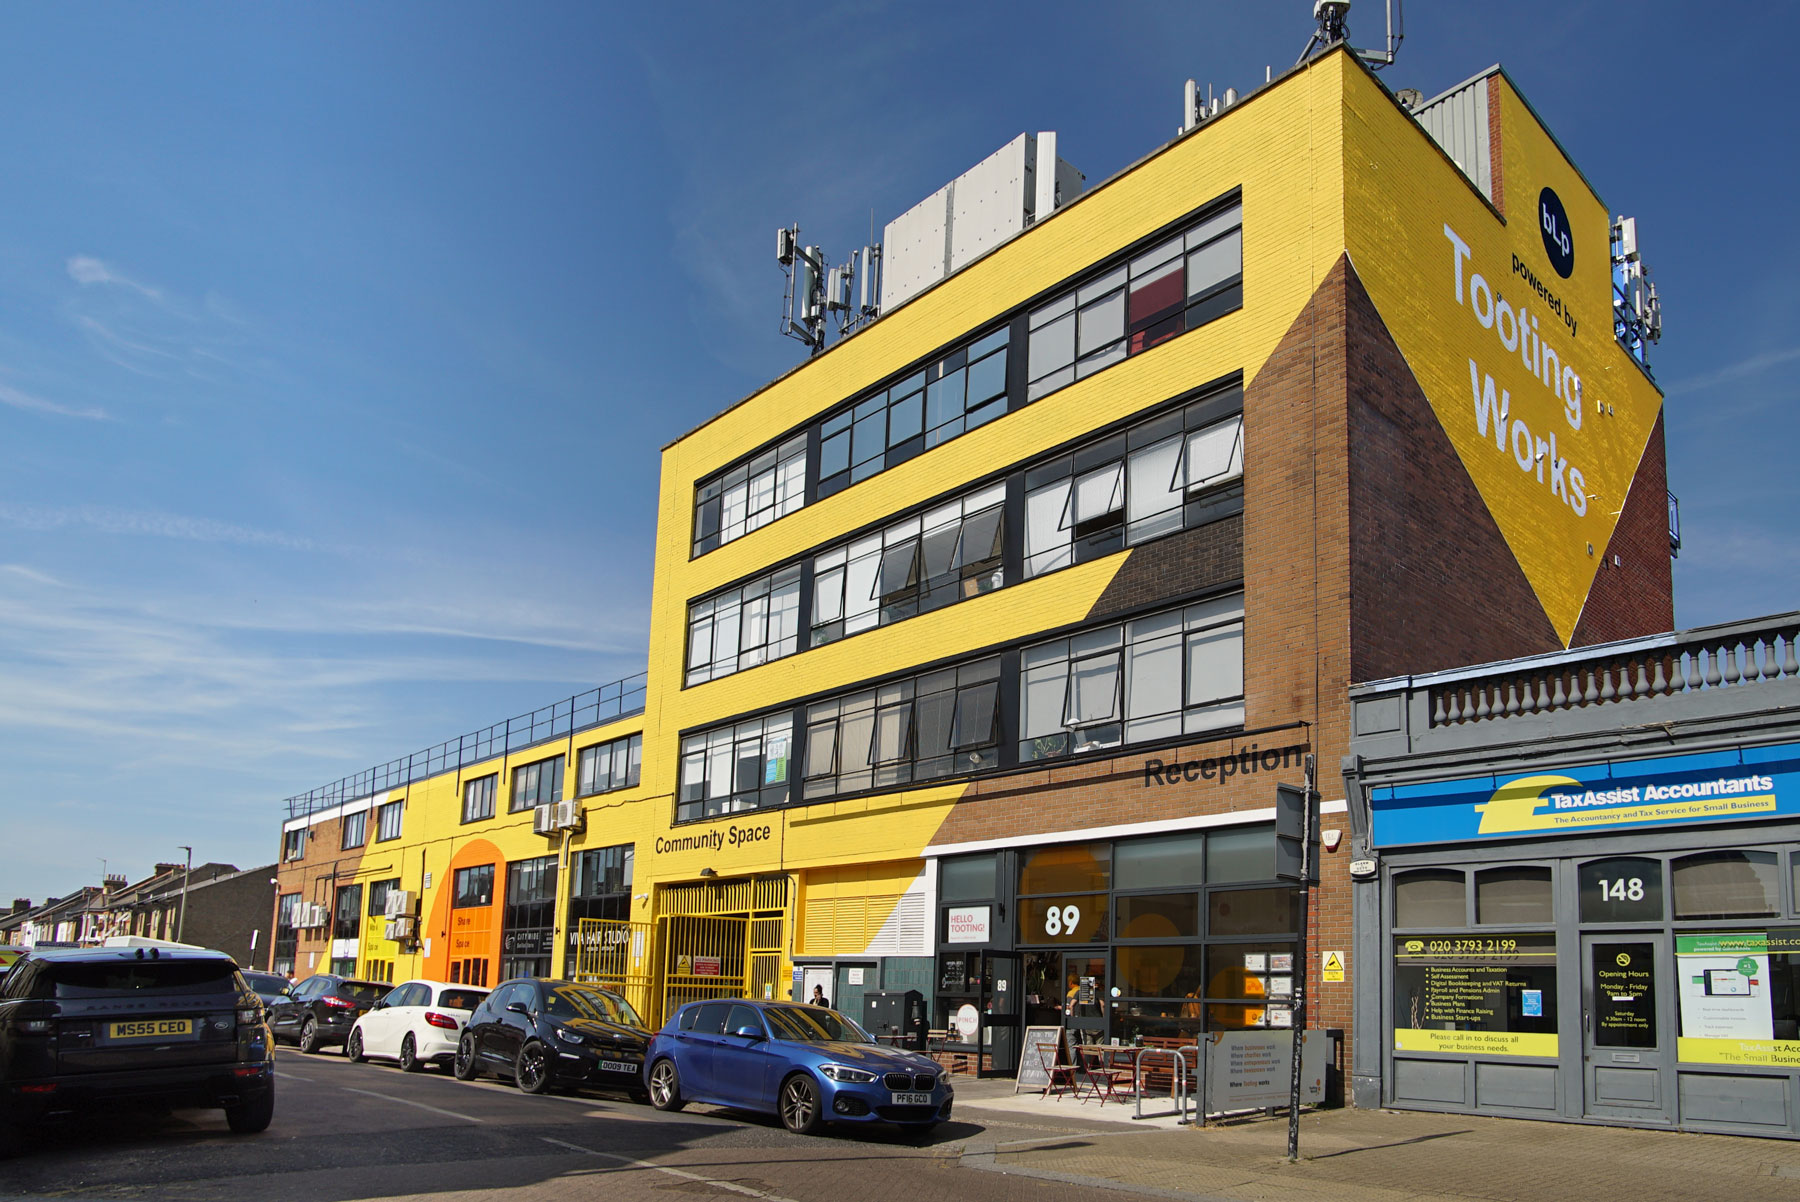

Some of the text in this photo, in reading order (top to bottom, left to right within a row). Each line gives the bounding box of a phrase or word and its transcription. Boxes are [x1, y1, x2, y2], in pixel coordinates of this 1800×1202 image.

[1511, 252, 1578, 338] powered by
[1443, 223, 1583, 431] Tooting
[1468, 357, 1588, 518] Works
[1143, 742, 1302, 788] Reception
[1550, 774, 1774, 810] TaxAssist Accountants
[1554, 799, 1770, 824] The Accountancy and Tax Service for Small Business
[655, 824, 771, 855] Community Space
[1598, 877, 1645, 903] 148
[950, 914, 974, 924] HELLO
[1045, 905, 1080, 936] 89
[950, 923, 985, 934] TOOTING!
[586, 931, 602, 945] HAR
[1429, 939, 1517, 952] 020 3793 2199
[1598, 970, 1627, 979] Opening
[997, 979, 1007, 991] 89
[1430, 980, 1447, 988] Digital
[1629, 983, 1648, 991] Friday
[1430, 1007, 1444, 1015] Help
[116, 1021, 186, 1037] MS55 CEO
[1430, 1033, 1451, 1041] Please
[1484, 1035, 1509, 1043] discuss
[1438, 1042, 1509, 1052] your business needs.
[1743, 1053, 1768, 1062] Small
[623, 1063, 636, 1072] TEA
[896, 1094, 913, 1103] PF16
